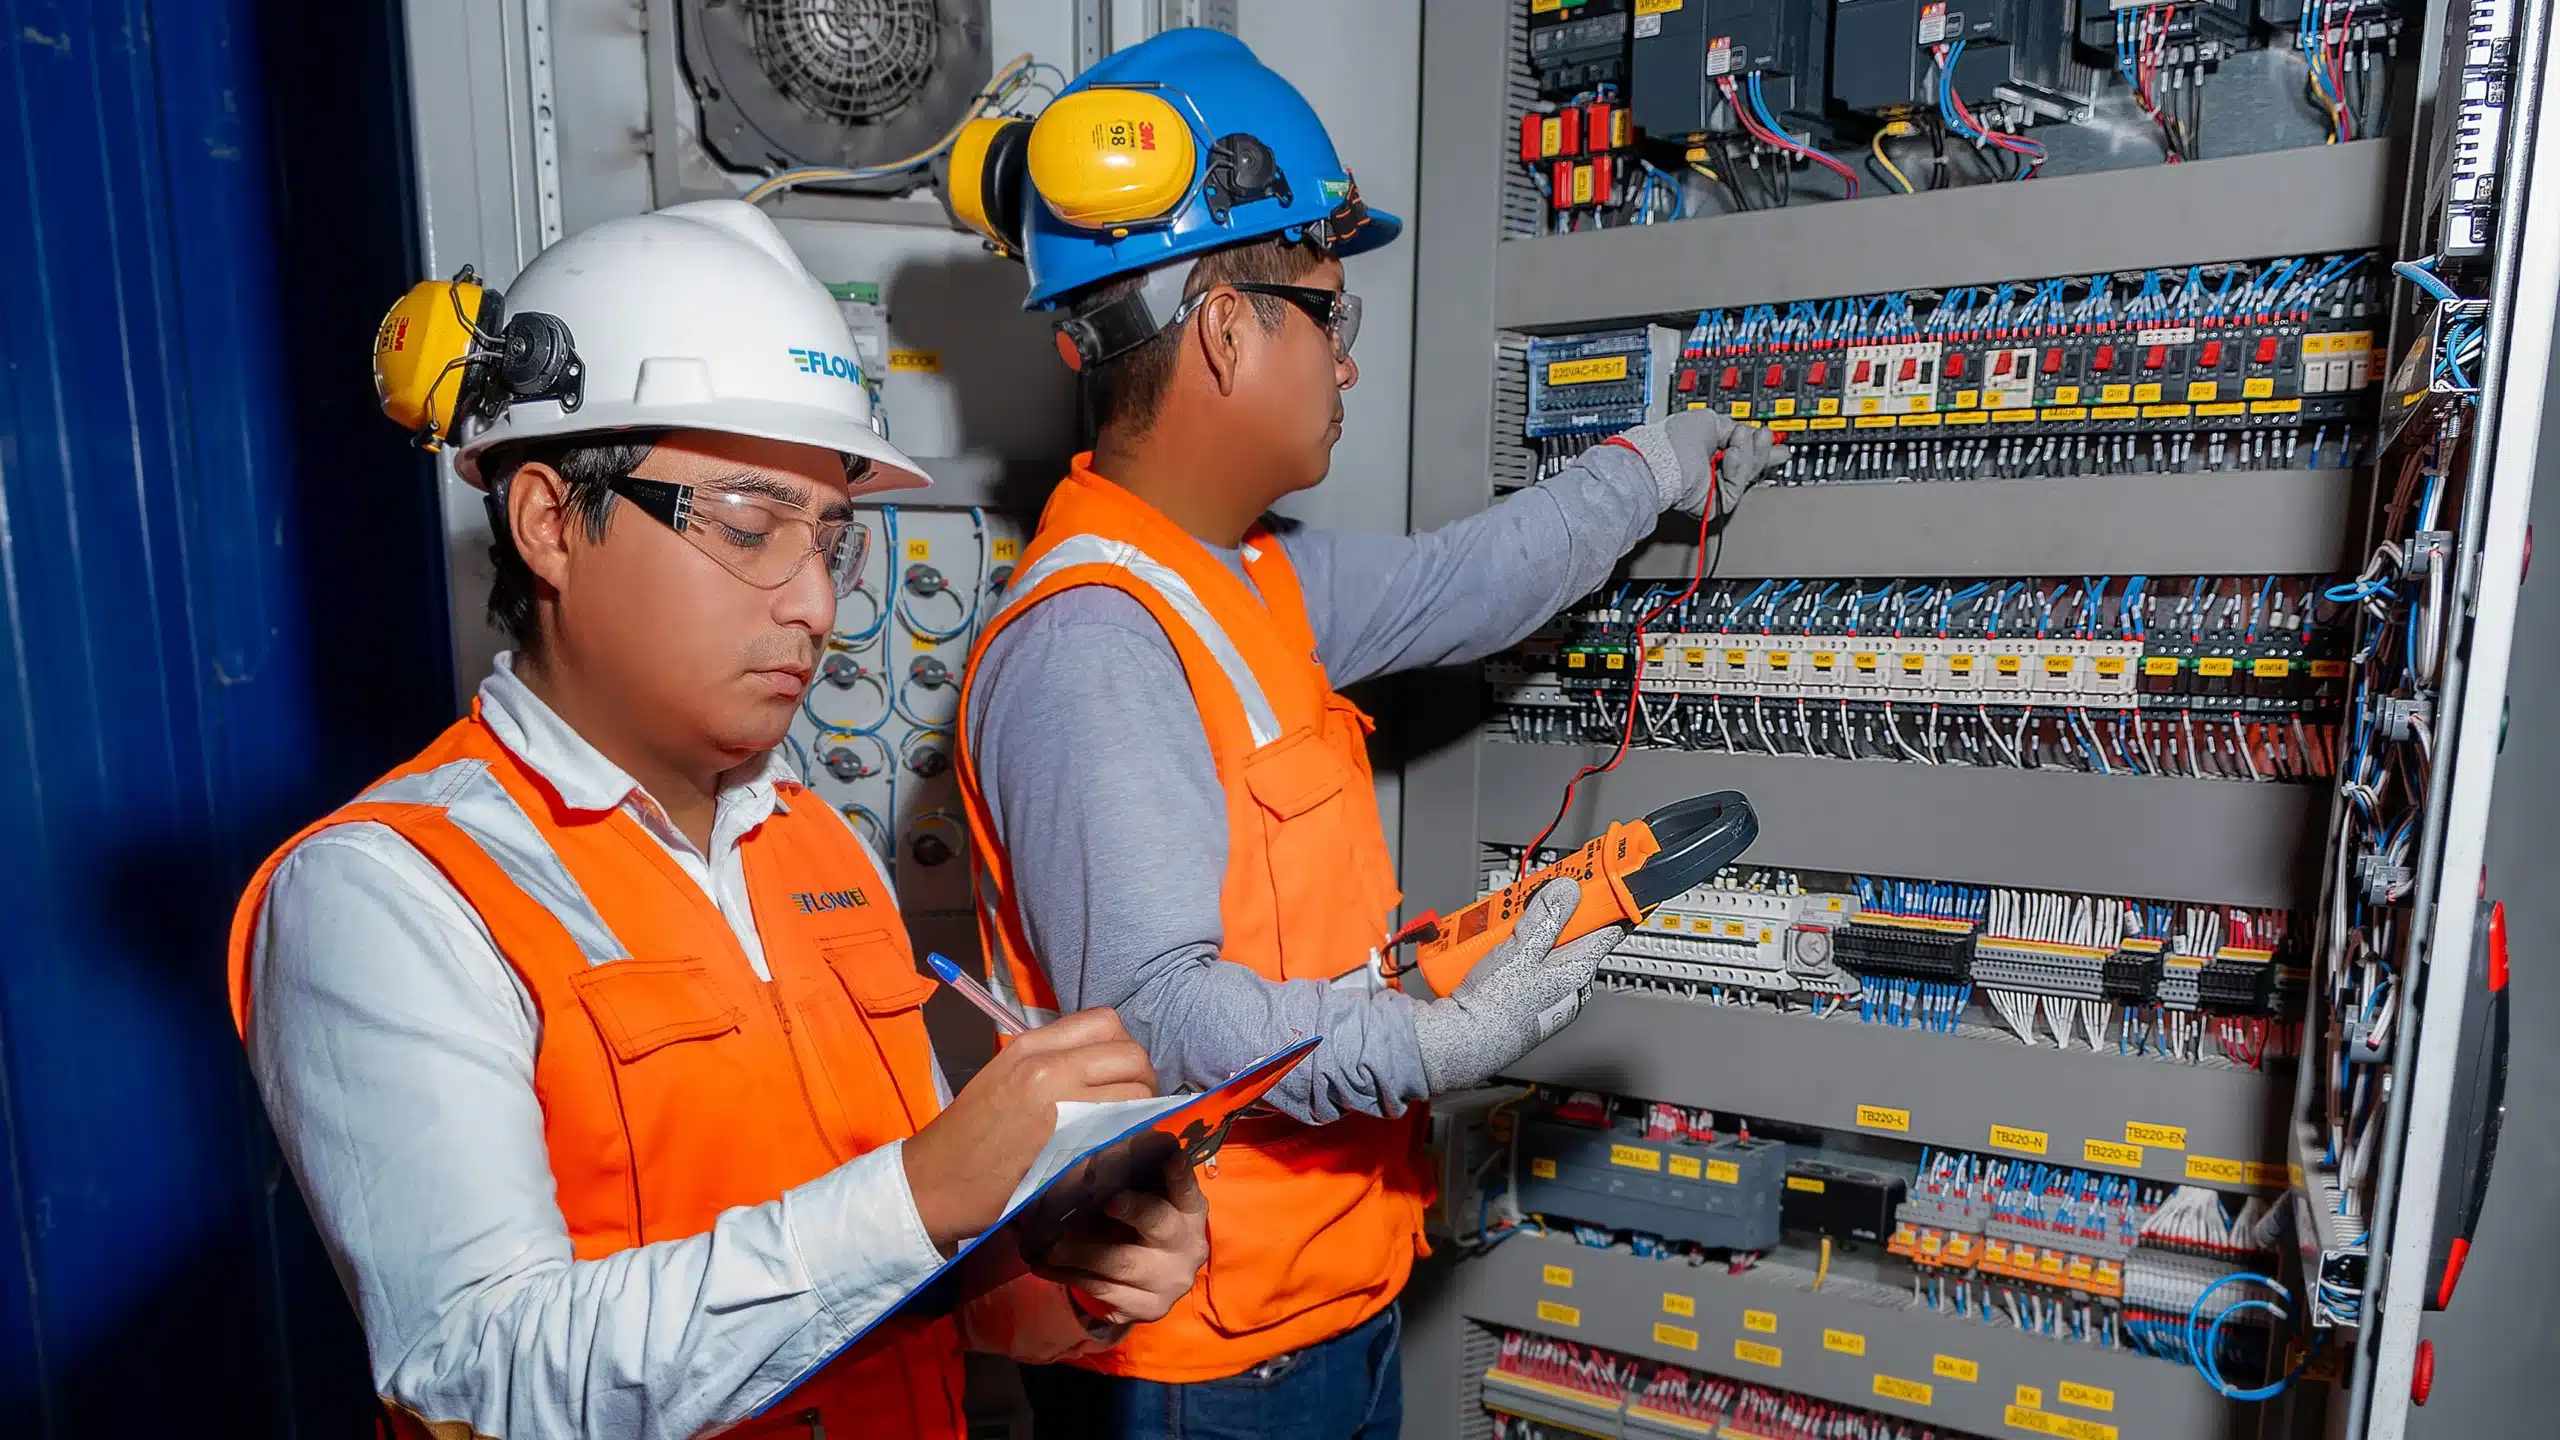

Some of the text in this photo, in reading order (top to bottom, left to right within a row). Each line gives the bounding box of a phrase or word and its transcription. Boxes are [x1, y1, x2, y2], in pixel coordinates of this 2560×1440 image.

[1110, 125, 1126, 146] 98
[1138, 121, 1156, 151] 3M
[393, 316, 410, 352] 3M
[1862, 1109, 1905, 1125] TB220-L
[1996, 1129, 2043, 1148] TB220-N
[2127, 1126, 2185, 1143] TB220-EN
[2086, 1143, 2140, 1162] TB220-EL
